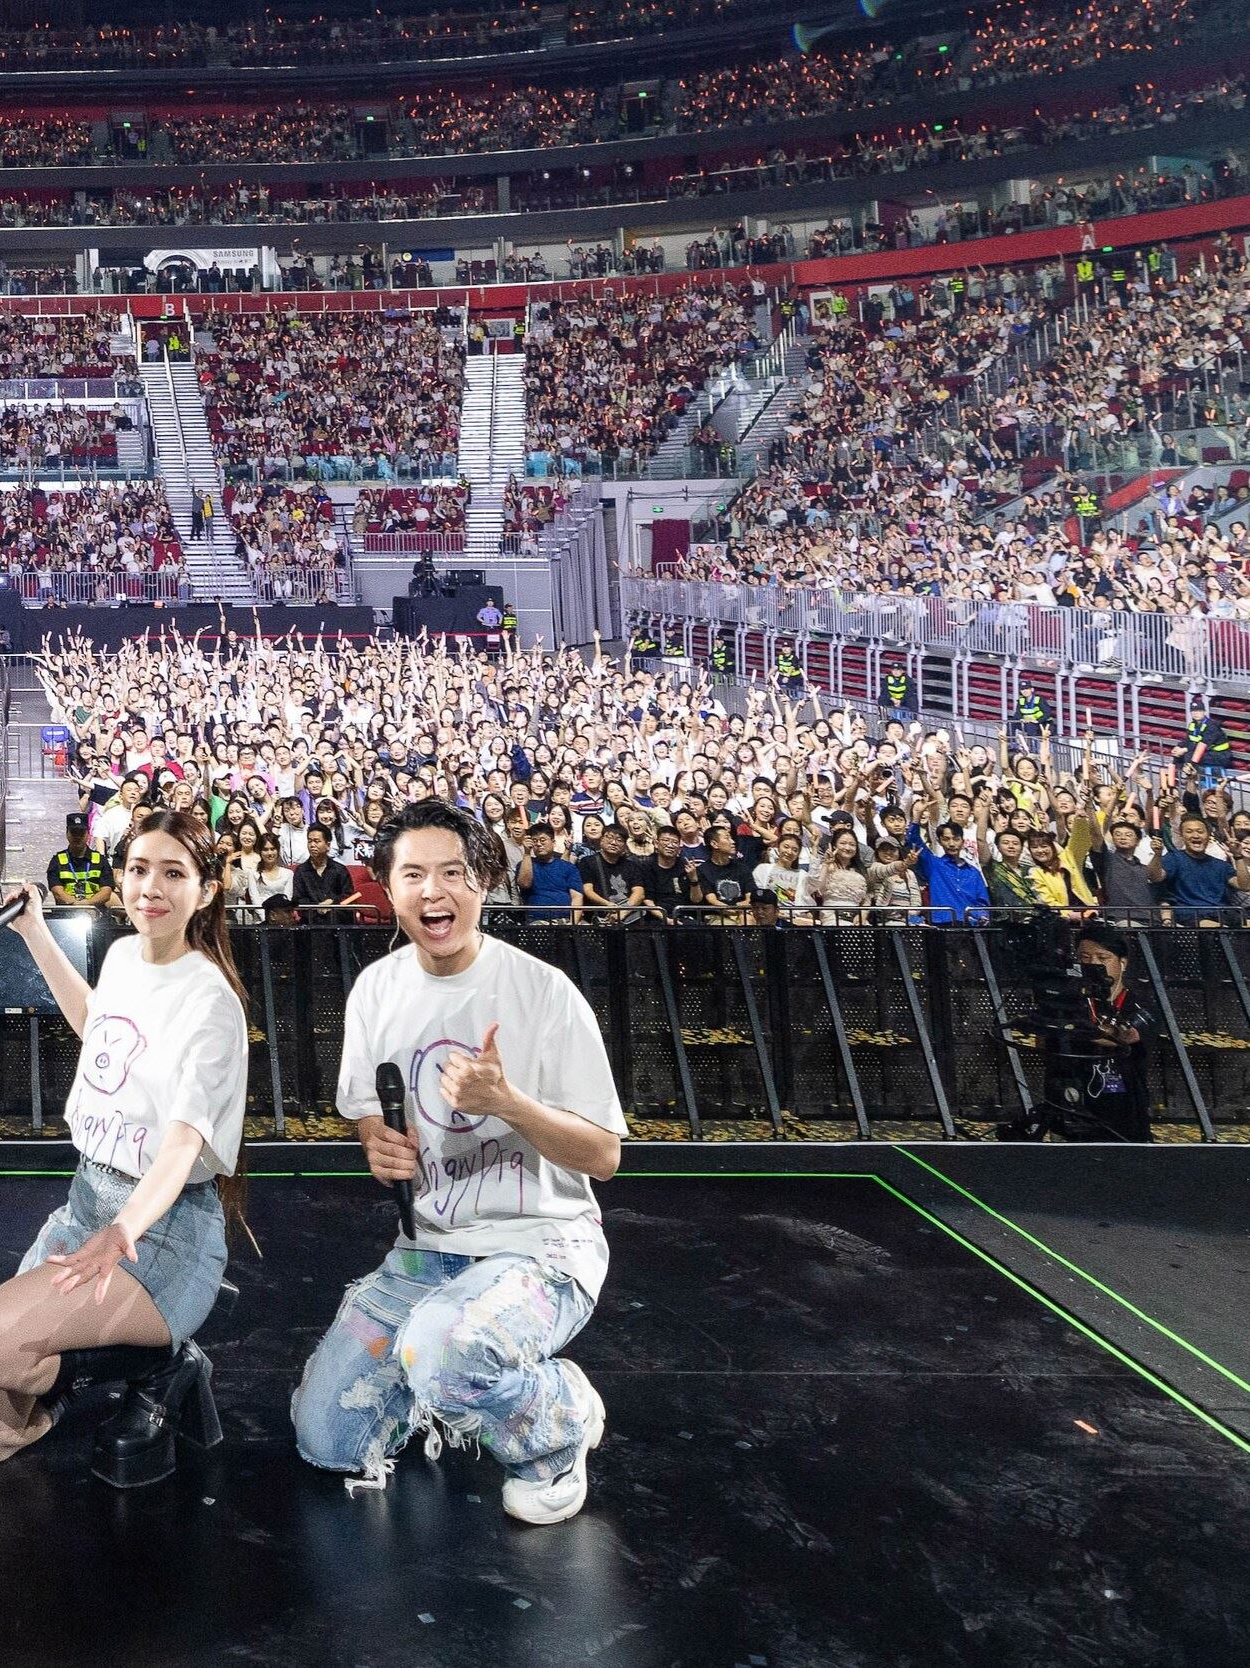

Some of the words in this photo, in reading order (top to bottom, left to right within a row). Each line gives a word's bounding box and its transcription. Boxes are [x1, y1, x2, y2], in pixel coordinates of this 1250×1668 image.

[1082, 235, 1096, 251] A
[213, 250, 253, 258] SAMSUNG
[165, 303, 175, 316] B
